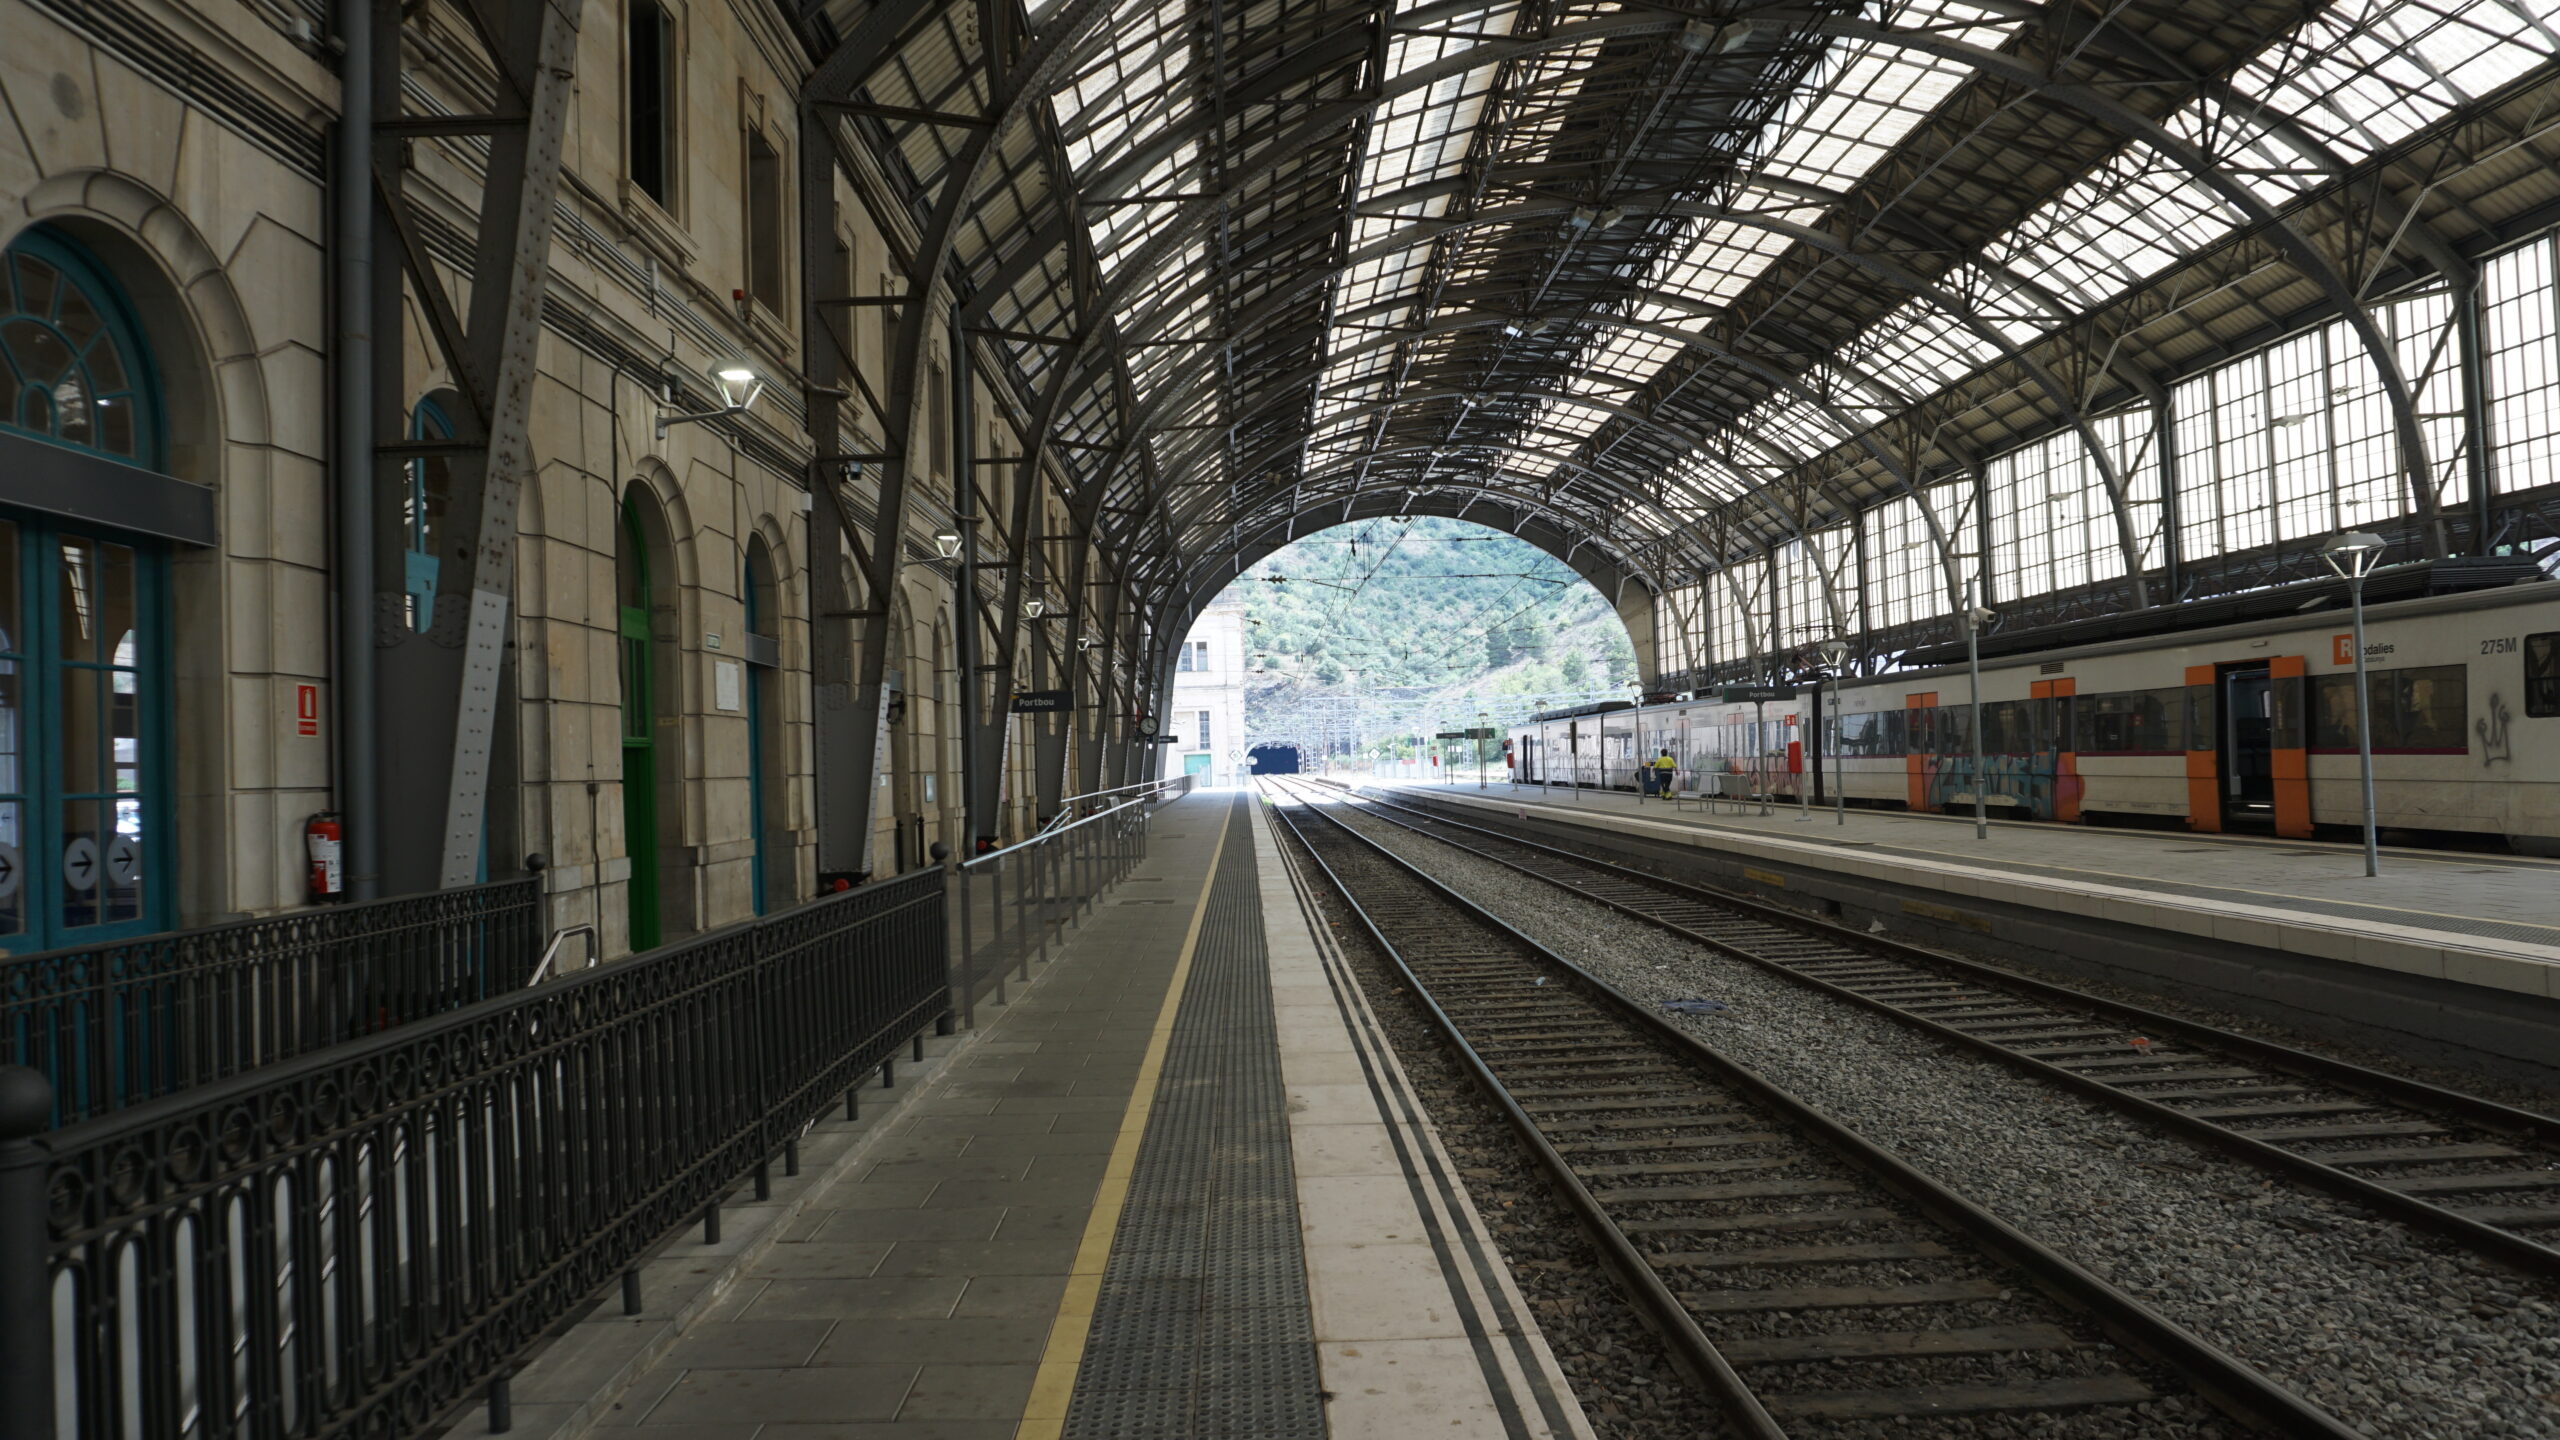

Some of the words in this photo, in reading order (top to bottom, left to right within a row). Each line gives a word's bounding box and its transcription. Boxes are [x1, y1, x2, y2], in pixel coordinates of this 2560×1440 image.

[2362, 643, 2395, 656] odalies
[2480, 637, 2517, 655] 275M
[1018, 698, 1055, 707] Portbou
